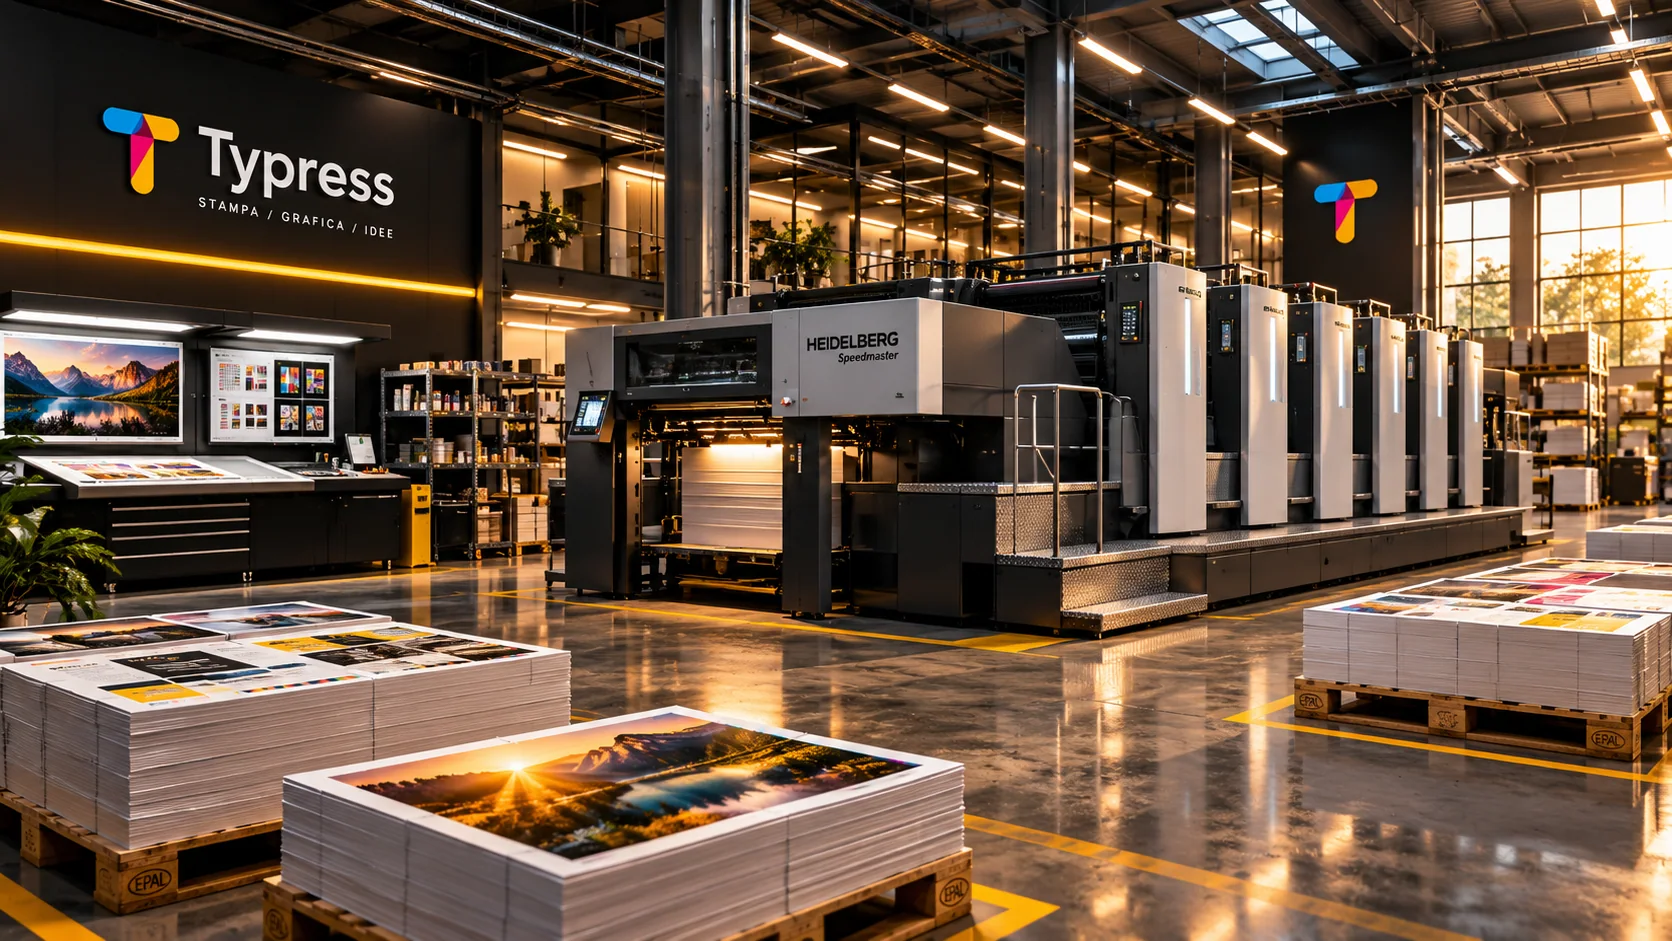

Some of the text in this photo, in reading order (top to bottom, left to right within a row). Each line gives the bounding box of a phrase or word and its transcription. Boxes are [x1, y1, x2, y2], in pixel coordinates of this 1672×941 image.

[198, 125, 395, 206] Typress
[198, 197, 259, 217] STAMPA
[281, 211, 344, 231] GRAFICA
[364, 225, 394, 239] IDEE
[806, 331, 899, 351] HEIDELBERG
[838, 351, 899, 364] Speedmaster
[1595, 733, 1620, 746] EPAL
[135, 872, 166, 892] EPAL
[944, 881, 963, 902] EPAL
